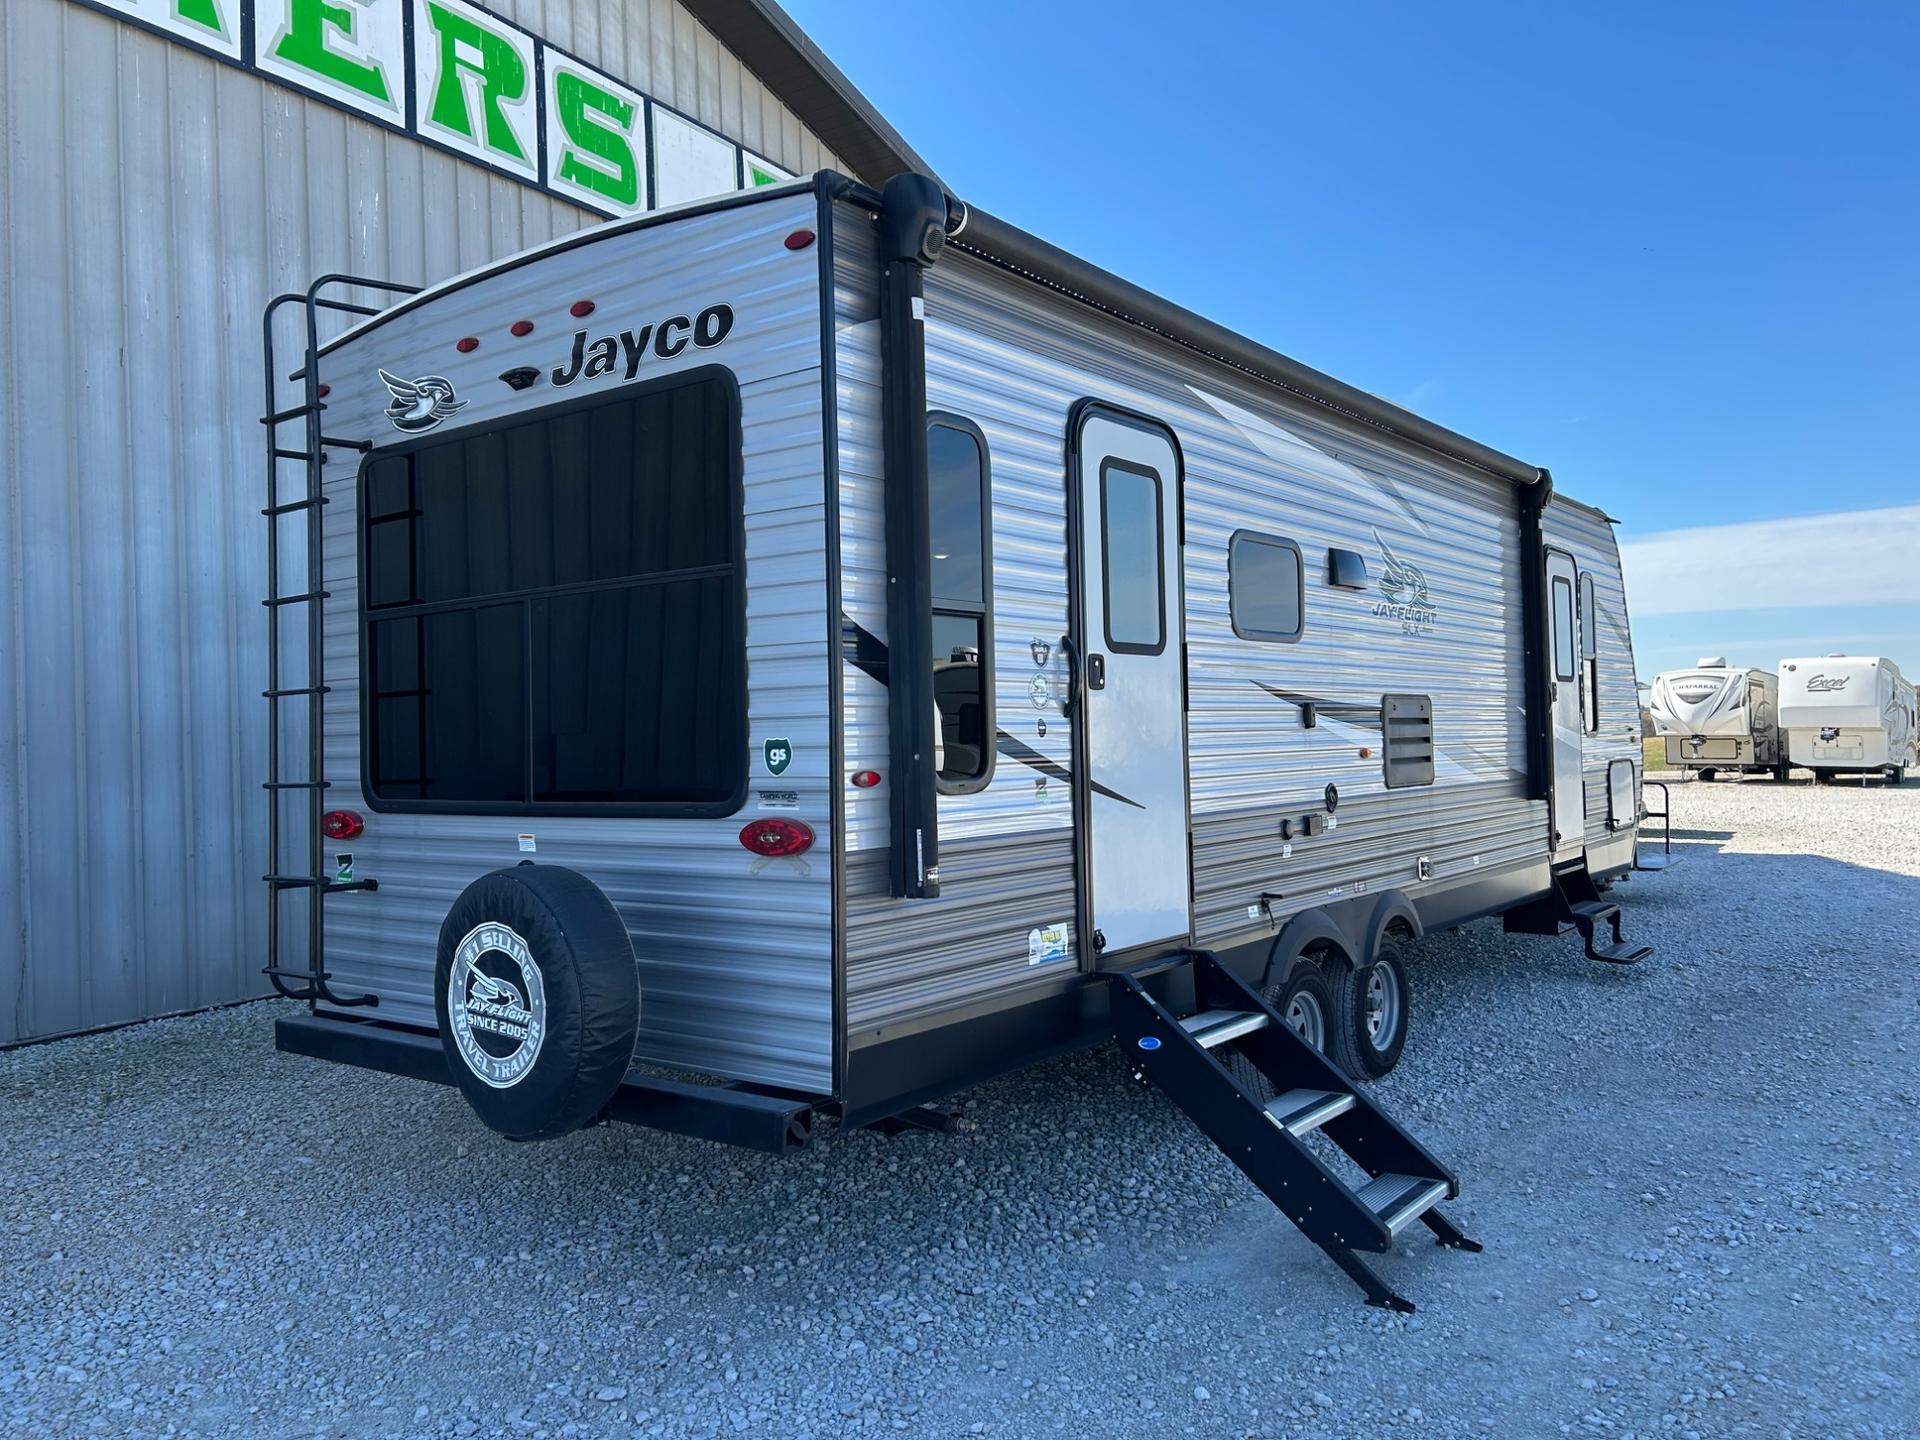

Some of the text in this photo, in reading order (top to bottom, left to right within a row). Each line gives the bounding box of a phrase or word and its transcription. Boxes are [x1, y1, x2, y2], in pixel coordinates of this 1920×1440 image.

[118, 0, 640, 210] ERS
[551, 302, 736, 388] Jayco
[770, 748, 786, 766] gs
[481, 931, 534, 981] SELLING
[455, 999, 541, 1077] TRAVEL TRAILER
[467, 1013, 529, 1041] SINCE 2005
